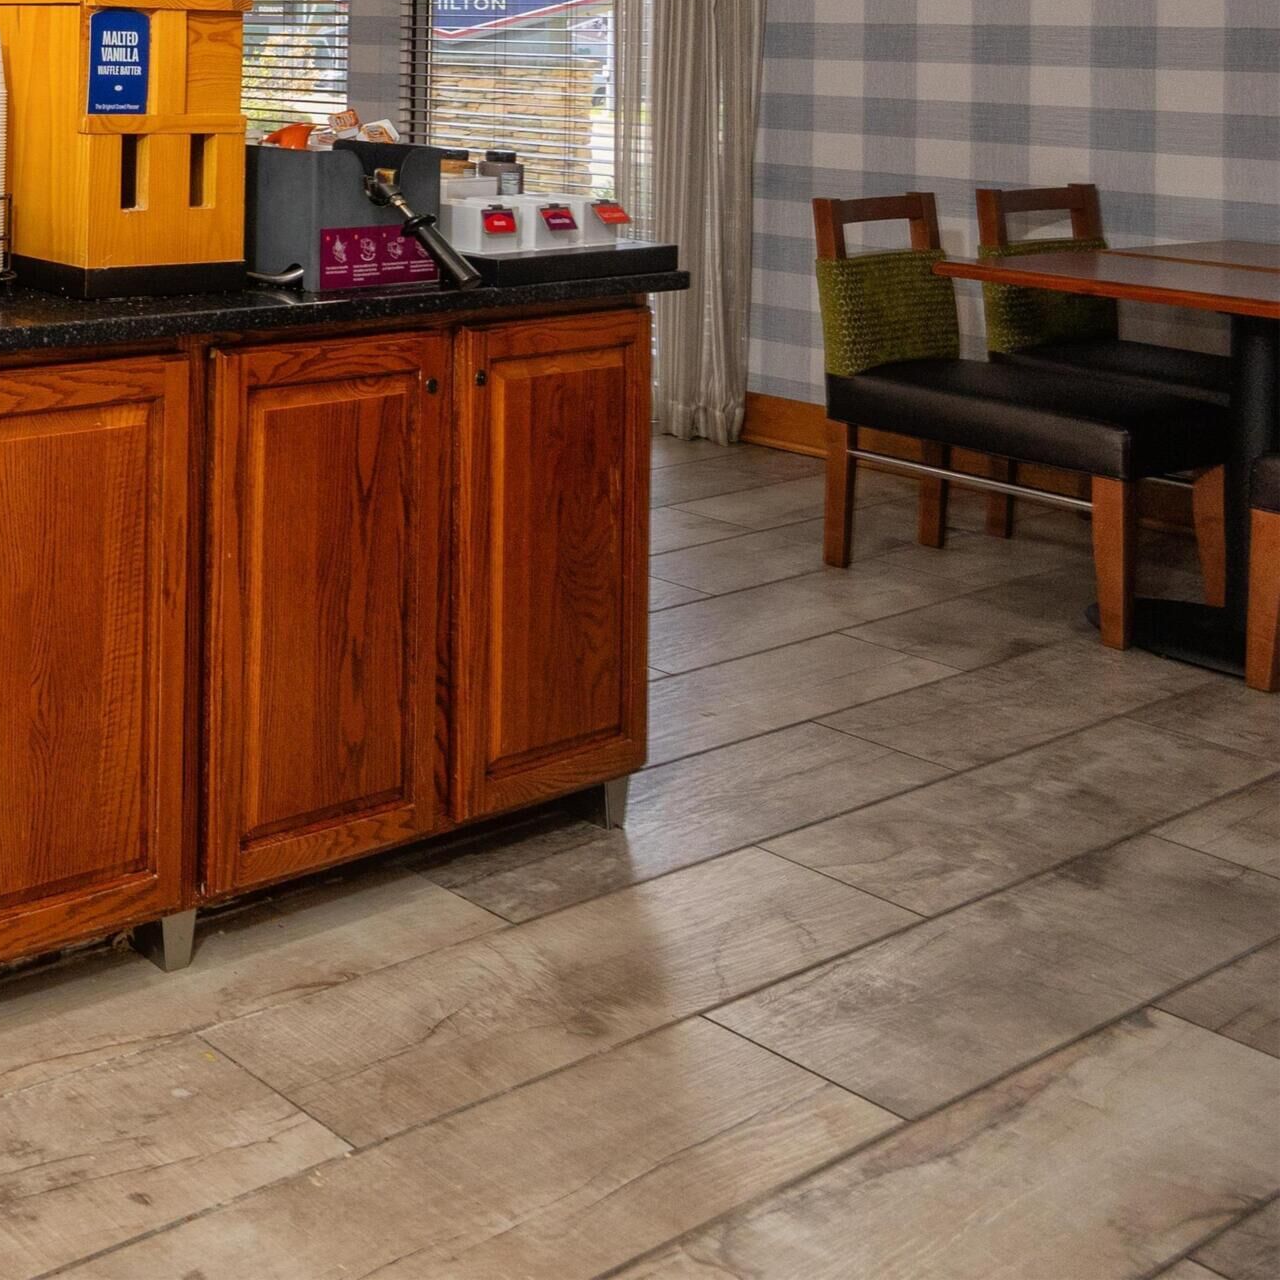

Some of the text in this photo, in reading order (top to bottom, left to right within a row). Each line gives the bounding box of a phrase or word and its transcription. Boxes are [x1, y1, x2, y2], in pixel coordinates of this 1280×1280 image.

[102, 30, 139, 46] MALTED
[101, 47, 140, 62] VANILLA
[97, 65, 142, 76] WAFFLE BATTER
